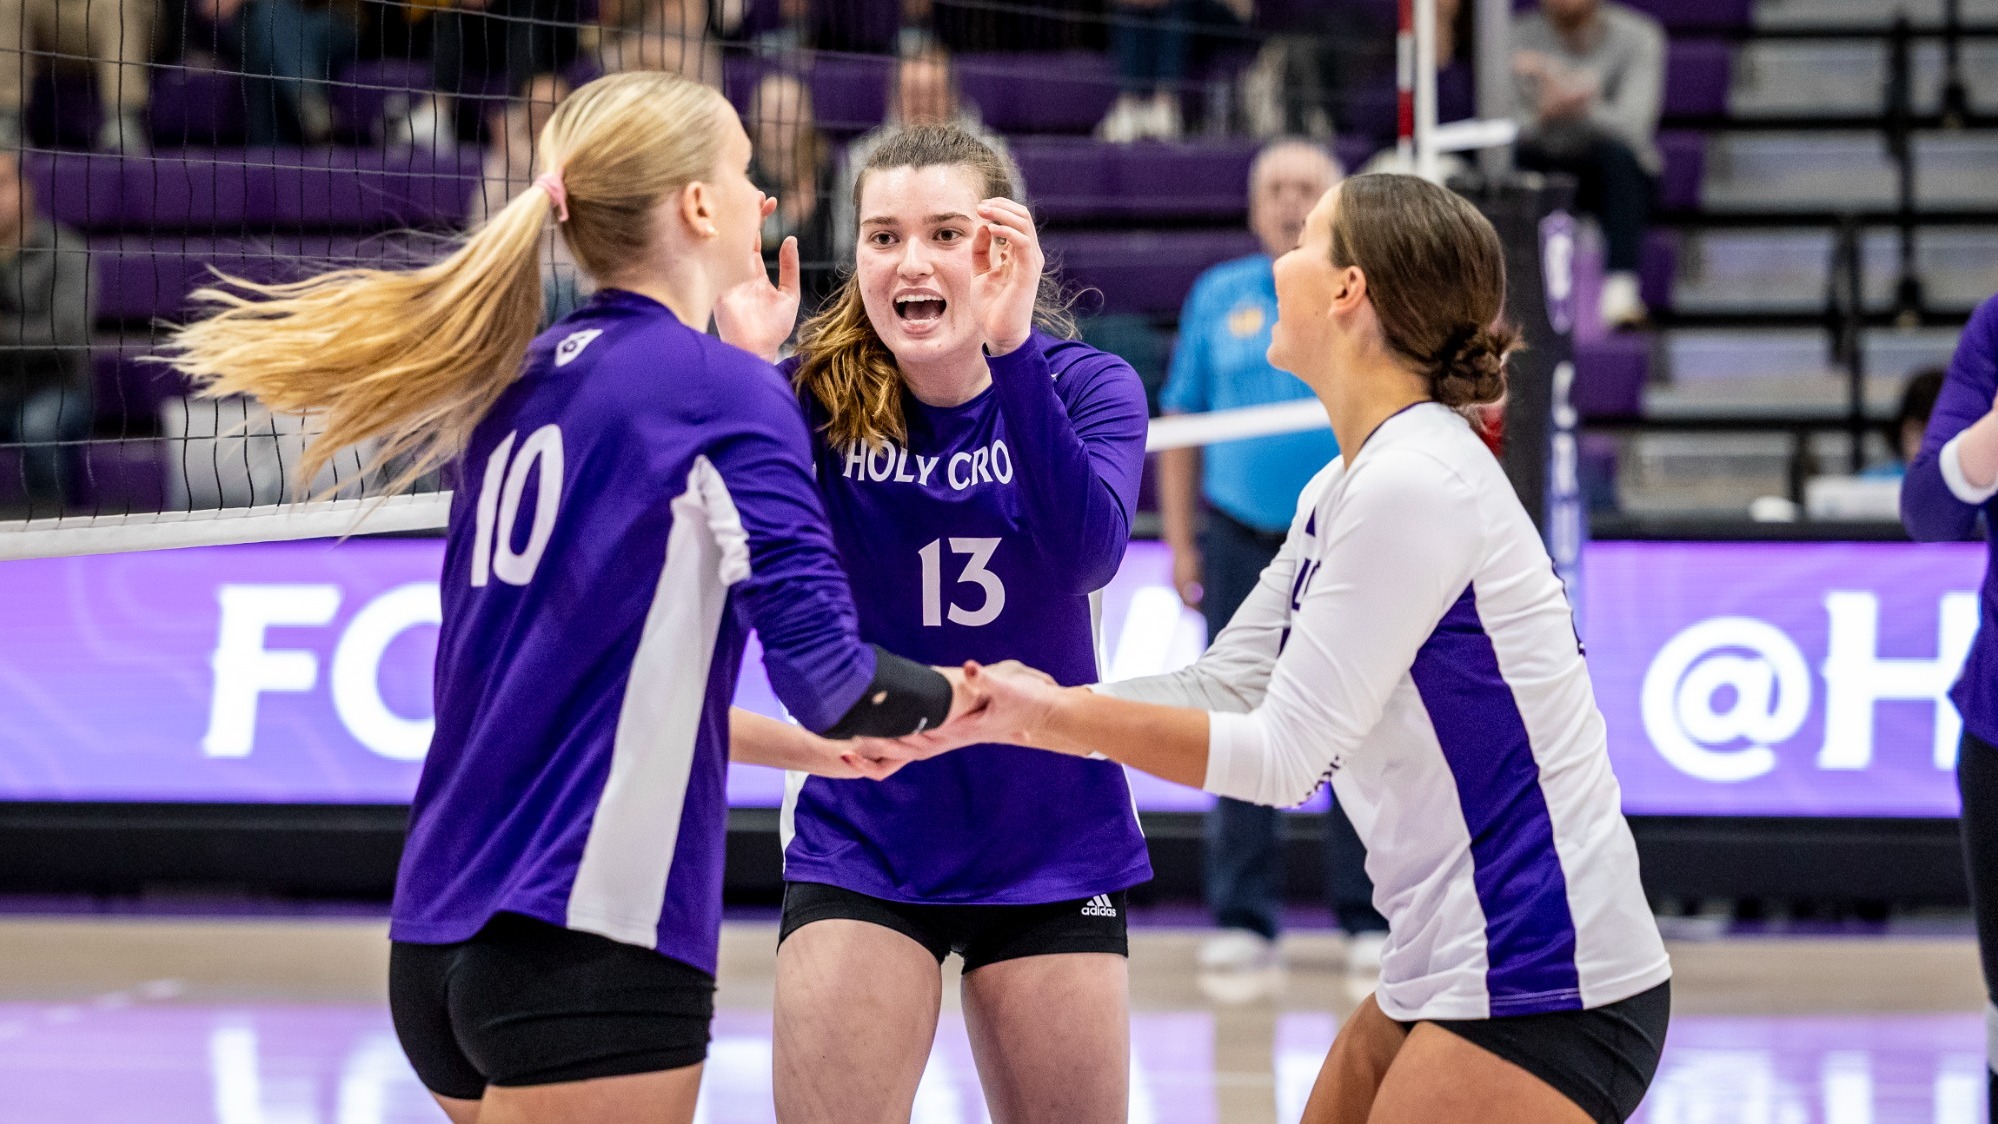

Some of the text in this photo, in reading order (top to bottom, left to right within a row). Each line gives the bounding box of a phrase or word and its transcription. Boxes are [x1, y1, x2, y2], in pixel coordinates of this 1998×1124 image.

[470, 423, 565, 588] 10
[842, 437, 940, 486] HOLY
[917, 537, 1006, 627] 13
[1640, 590, 1982, 782] @H
[1081, 905, 1117, 917] adidas
